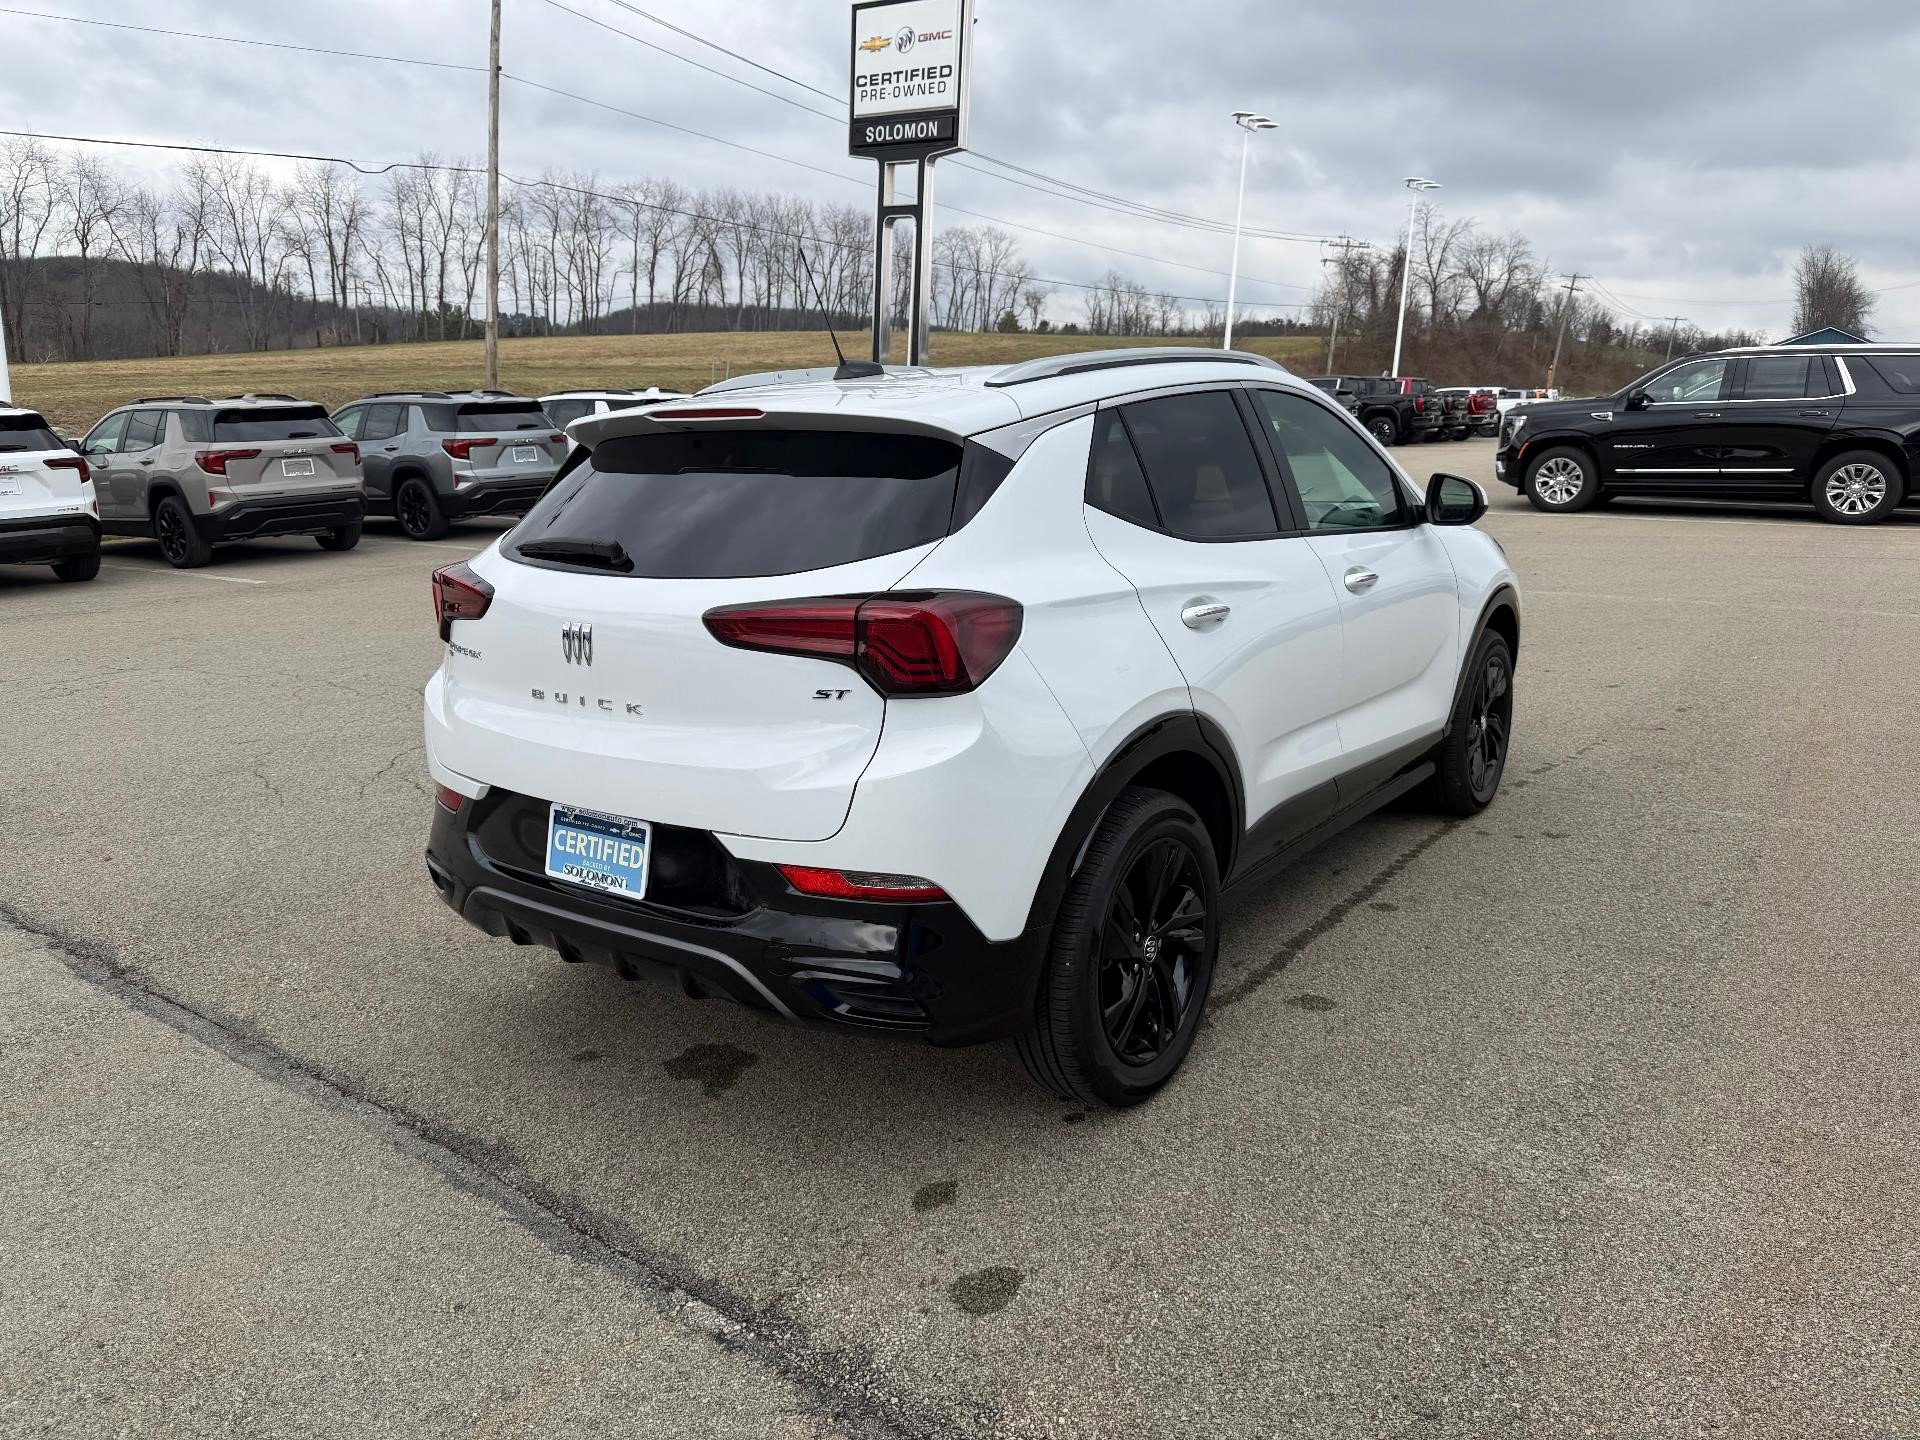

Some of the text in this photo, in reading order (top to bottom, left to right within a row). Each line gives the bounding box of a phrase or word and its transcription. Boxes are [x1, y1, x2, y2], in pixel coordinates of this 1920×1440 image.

[918, 30, 952, 42] GMC
[856, 65, 952, 87] CERTIFIED
[860, 81, 946, 102] PRE-OWNED
[866, 121, 938, 142] SOLOMON
[531, 688, 643, 715] BUICK
[812, 689, 851, 700] ST
[554, 829, 644, 868] CERTIFIED
[563, 863, 625, 888] SOLOMON
[583, 859, 611, 872] BACKED BY
